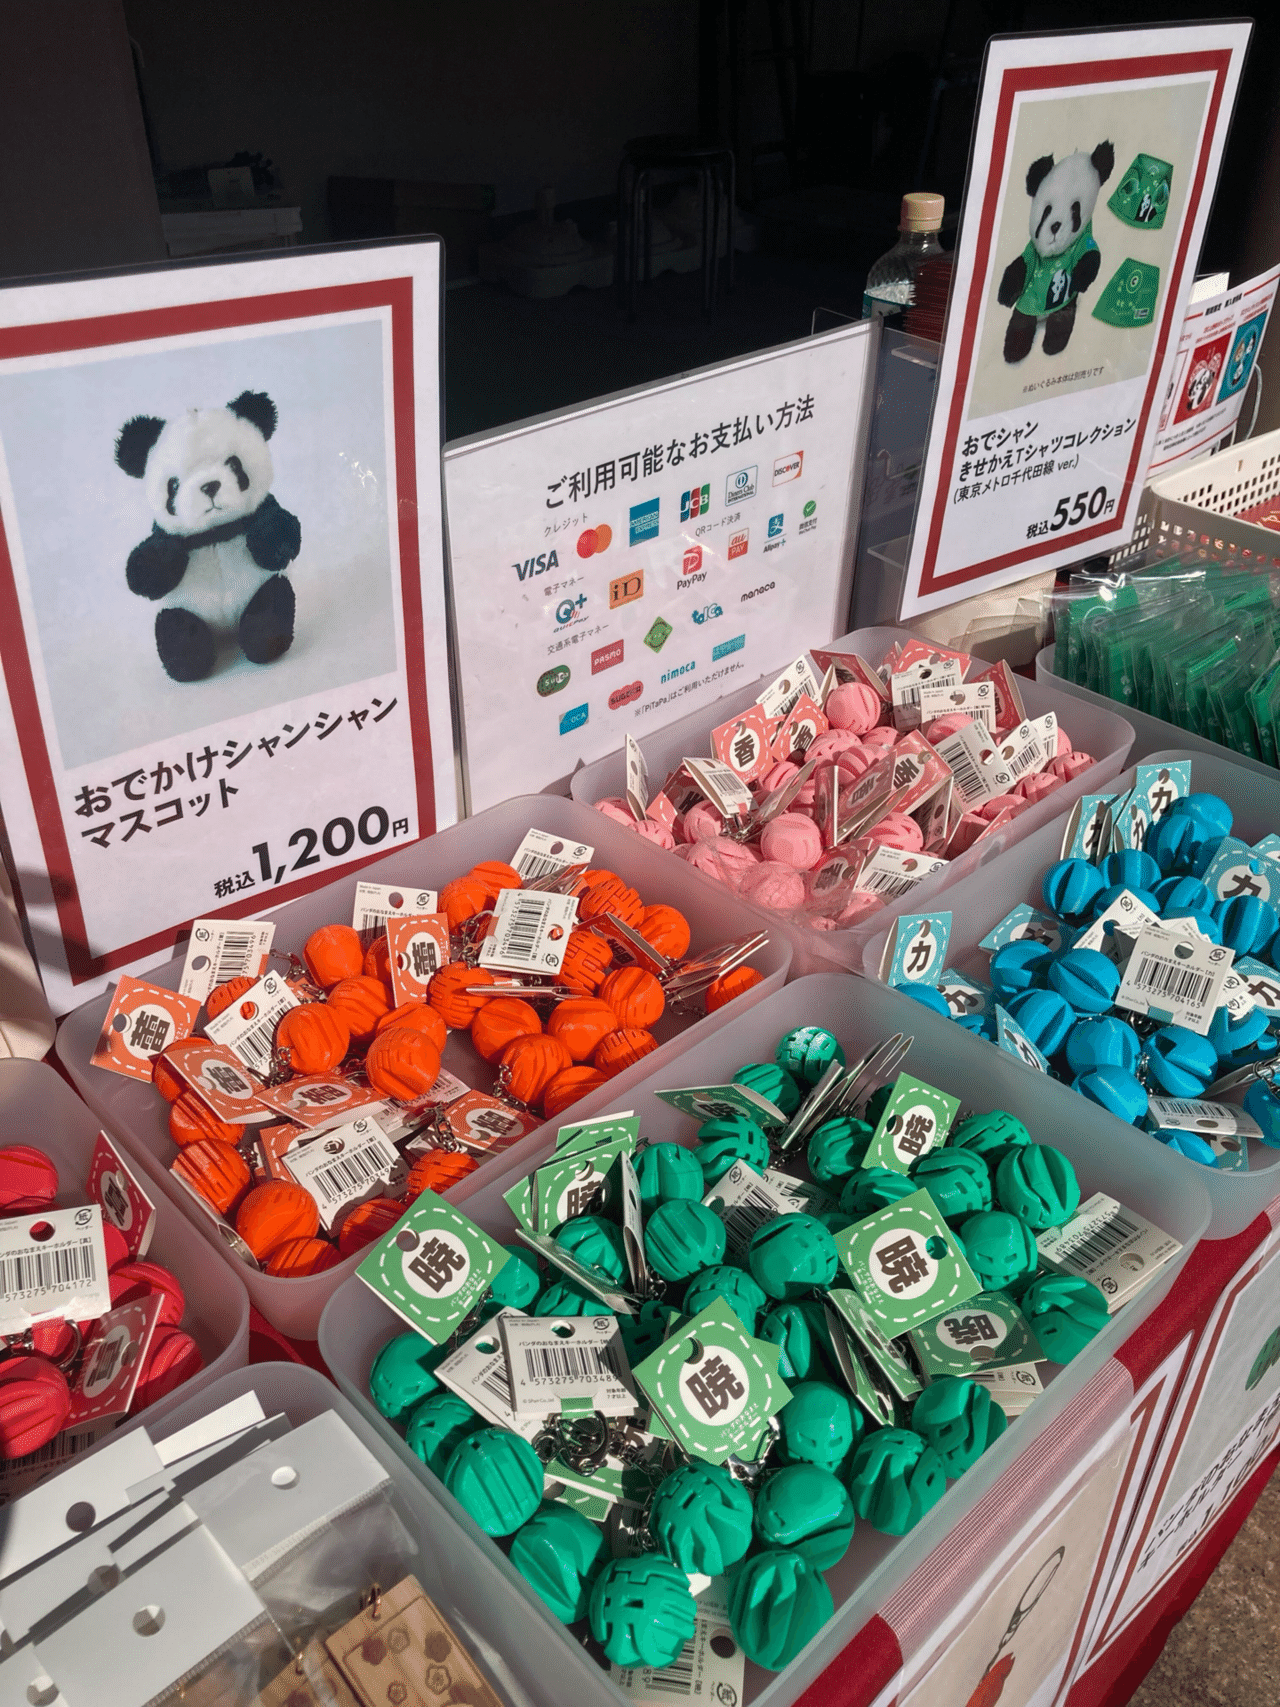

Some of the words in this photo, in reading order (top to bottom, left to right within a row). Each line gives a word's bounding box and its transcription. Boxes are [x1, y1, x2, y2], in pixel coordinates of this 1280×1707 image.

[545, 393, 815, 509] ご利用可能なお支払い方法
[959, 418, 1137, 482] きせかえTシャツコレクション
[961, 421, 1039, 457] おでシャン
[774, 461, 800, 476] DISCOVER
[1057, 453, 1080, 472] ver.)
[544, 513, 588, 537] クレジット
[694, 512, 741, 537] QRコード決済
[511, 549, 559, 581] VISA
[543, 576, 585, 597] 電子マネー
[611, 576, 642, 602] iD
[676, 571, 708, 591] PayPay
[740, 581, 776, 602] manaca
[547, 624, 610, 656] 交通系電子マネー
[660, 660, 696, 685] nimoca
[74, 696, 399, 817] おでかけシャンシャン
[734, 733, 756, 768] 香
[81, 778, 240, 849] マスコット
[1135, 982, 1167, 998] 573275
[1170, 993, 1201, 1009] 704165
[897, 1113, 934, 1157] 暁
[331, 1183, 364, 1206] 573275
[407, 1236, 467, 1294] 暁
[5, 1286, 47, 1303] 573275
[51, 1278, 92, 1294] 704172
[534, 1376, 575, 1386] 573275
[684, 1354, 746, 1419] 暁
